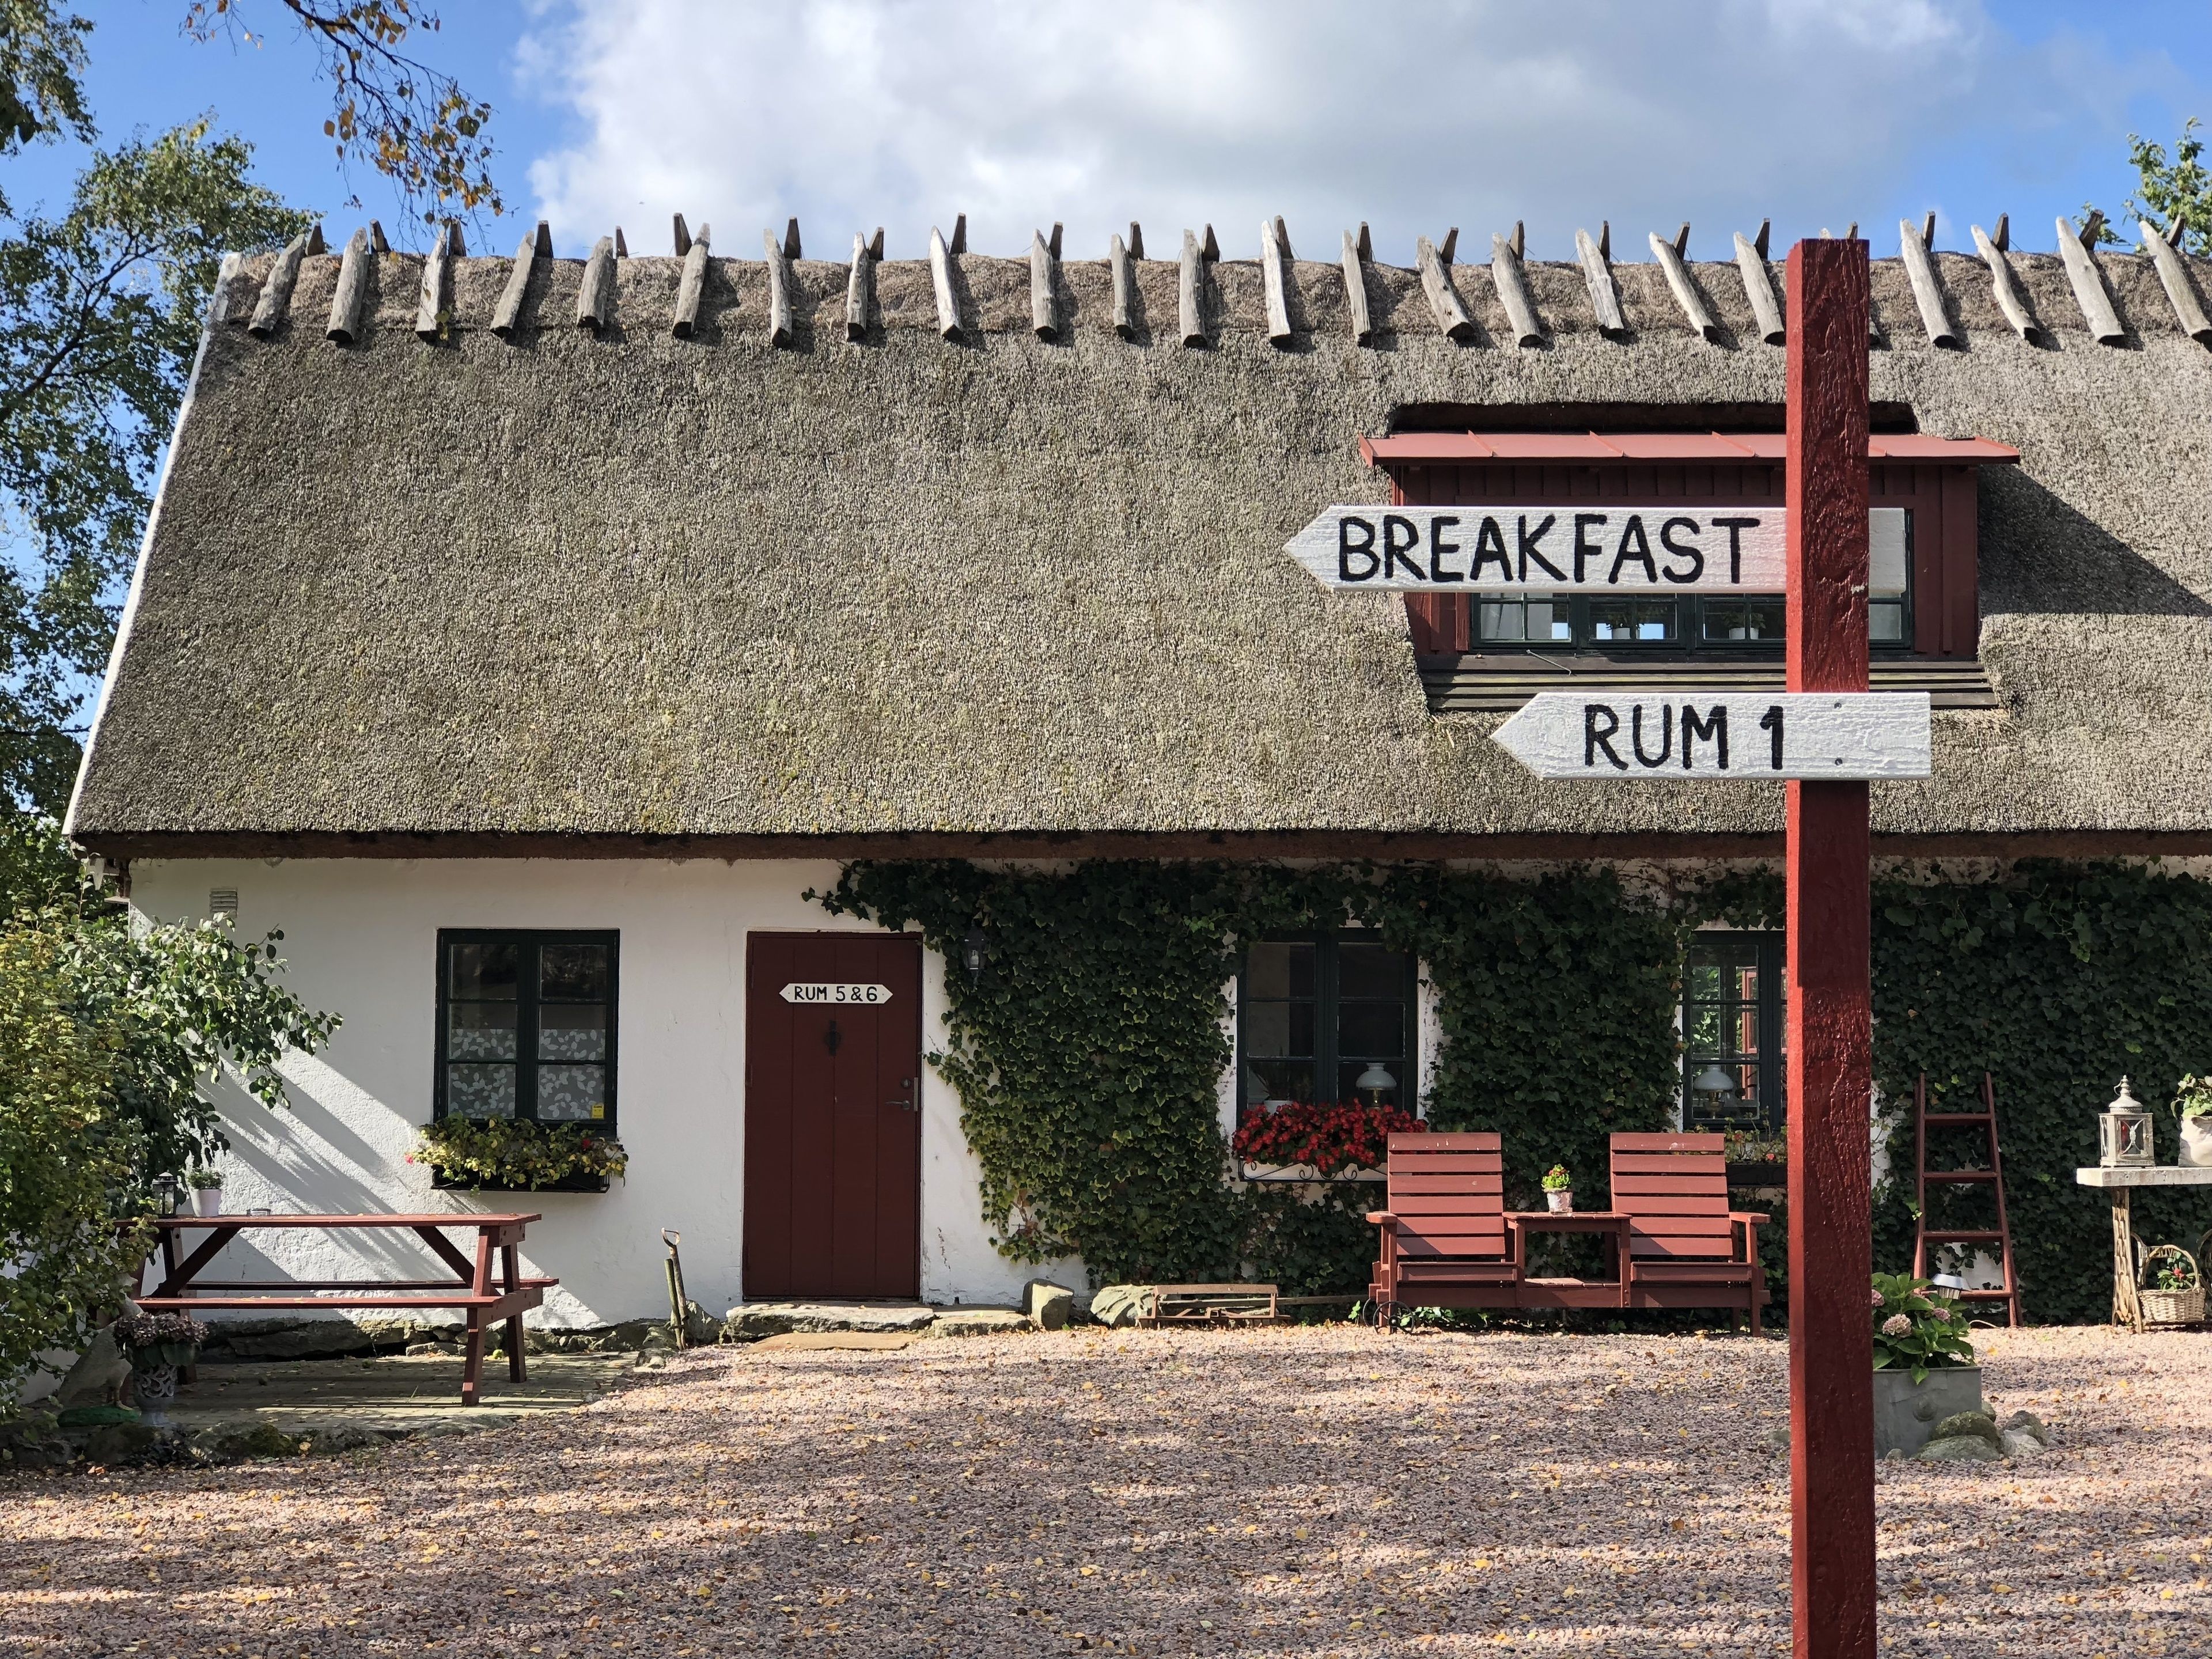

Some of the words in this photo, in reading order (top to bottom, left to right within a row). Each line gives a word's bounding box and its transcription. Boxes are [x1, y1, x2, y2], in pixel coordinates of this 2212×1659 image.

[1339, 513, 1761, 585] BREAKFAST
[1584, 703, 1729, 771] RUM
[1759, 705, 1785, 770] 1
[794, 986, 827, 1001] RUM
